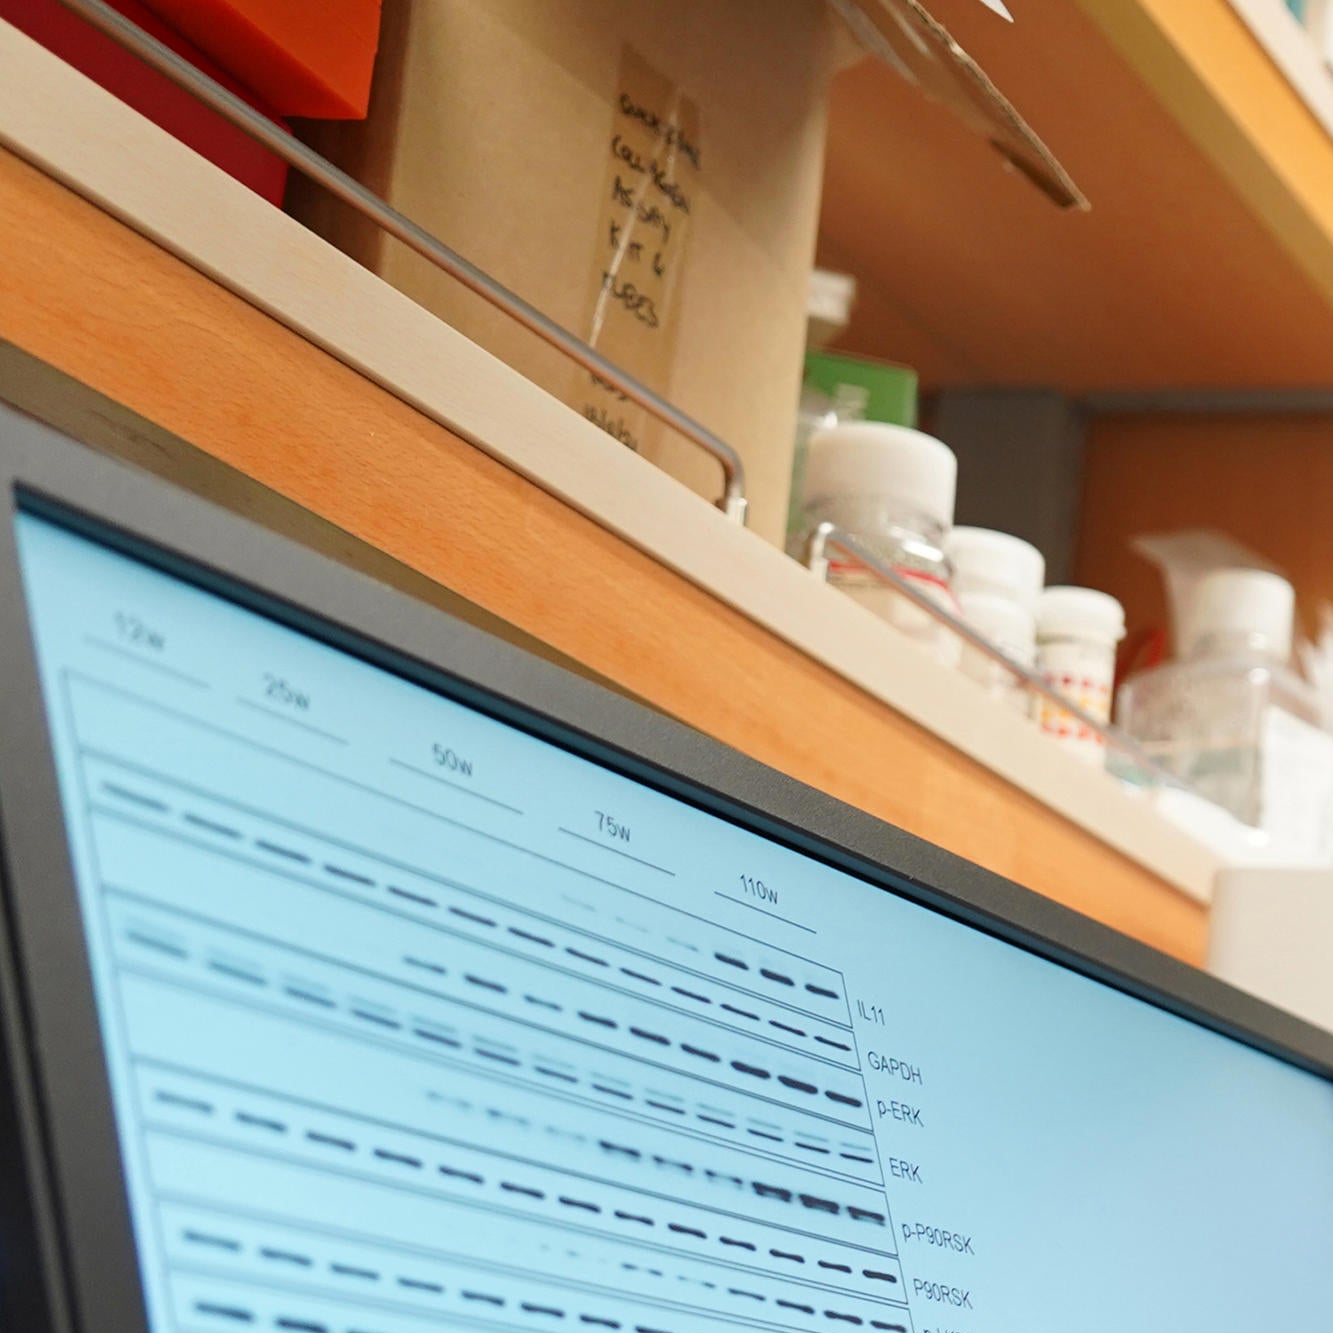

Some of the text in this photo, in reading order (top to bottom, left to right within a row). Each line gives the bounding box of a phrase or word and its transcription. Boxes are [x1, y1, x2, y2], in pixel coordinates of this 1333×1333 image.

[262, 670, 310, 712] 25w
[432, 743, 474, 777] 50w
[594, 811, 631, 844] 75w
[740, 873, 779, 905] 110w
[857, 1000, 885, 1026] IL11
[867, 1051, 923, 1085] GAPDH
[877, 1100, 924, 1127] p-ERK
[889, 1157, 923, 1184] ERK
[902, 1223, 975, 1255] p-P90RSK
[913, 1278, 973, 1310] P90RSK
